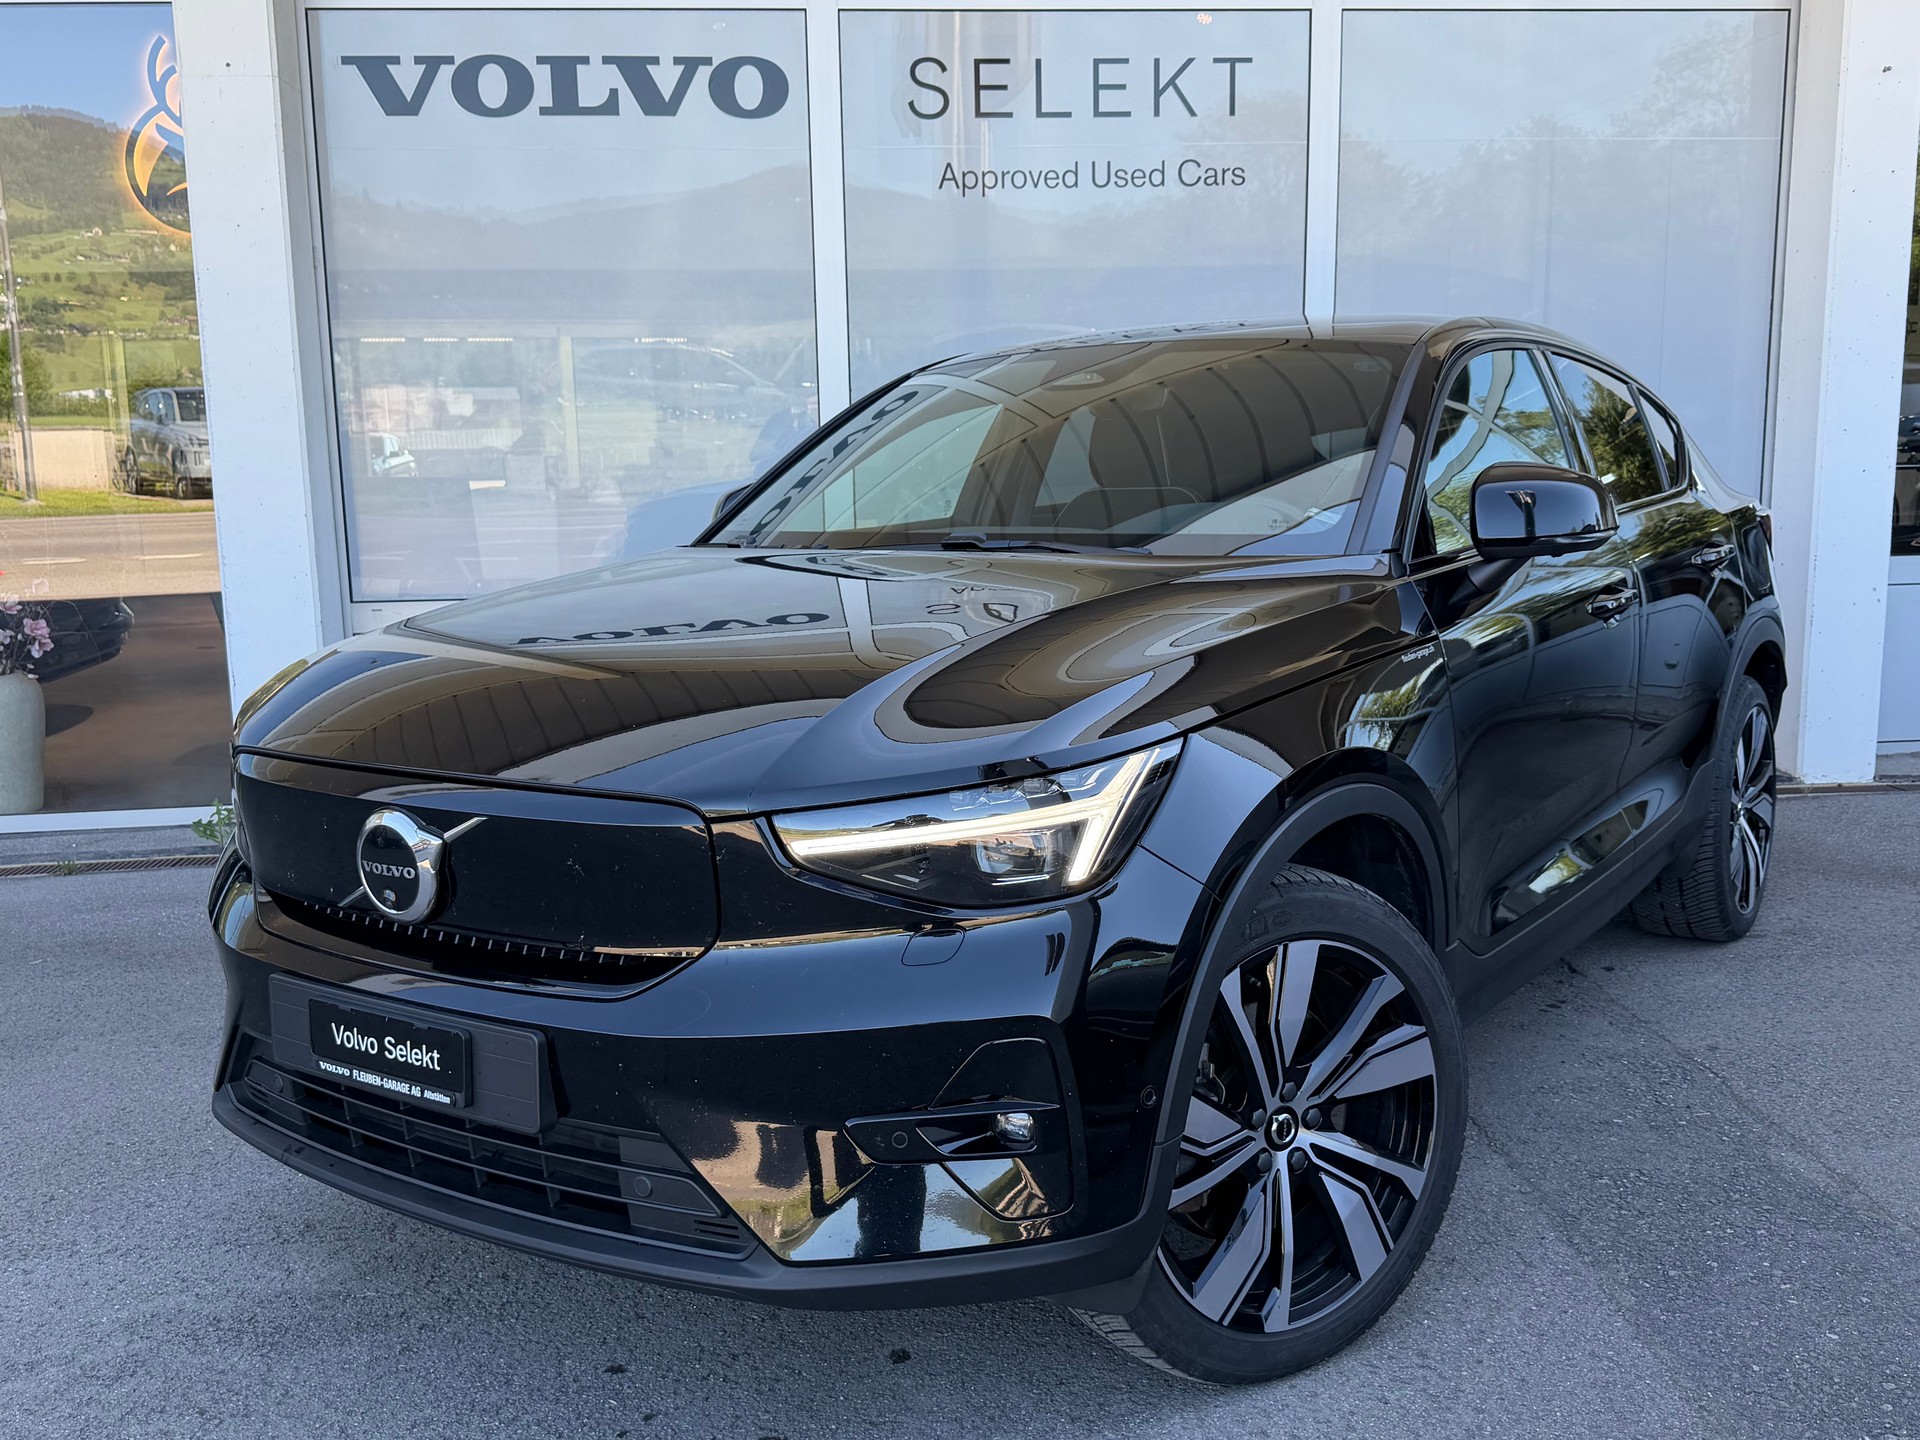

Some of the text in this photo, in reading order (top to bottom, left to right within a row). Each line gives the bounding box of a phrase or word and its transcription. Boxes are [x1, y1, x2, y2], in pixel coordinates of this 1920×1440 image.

[341, 54, 789, 118] VOLVO
[907, 56, 1253, 120] SELEKT
[938, 159, 1246, 198] Approved Used Cars
[361, 860, 416, 879] VOLVO
[331, 1022, 441, 1071] Volvo Selekt
[318, 1060, 350, 1077] VOLVO
[352, 1069, 410, 1095] FLEUBEN-GARAGE
[410, 1085, 422, 1098] AG
